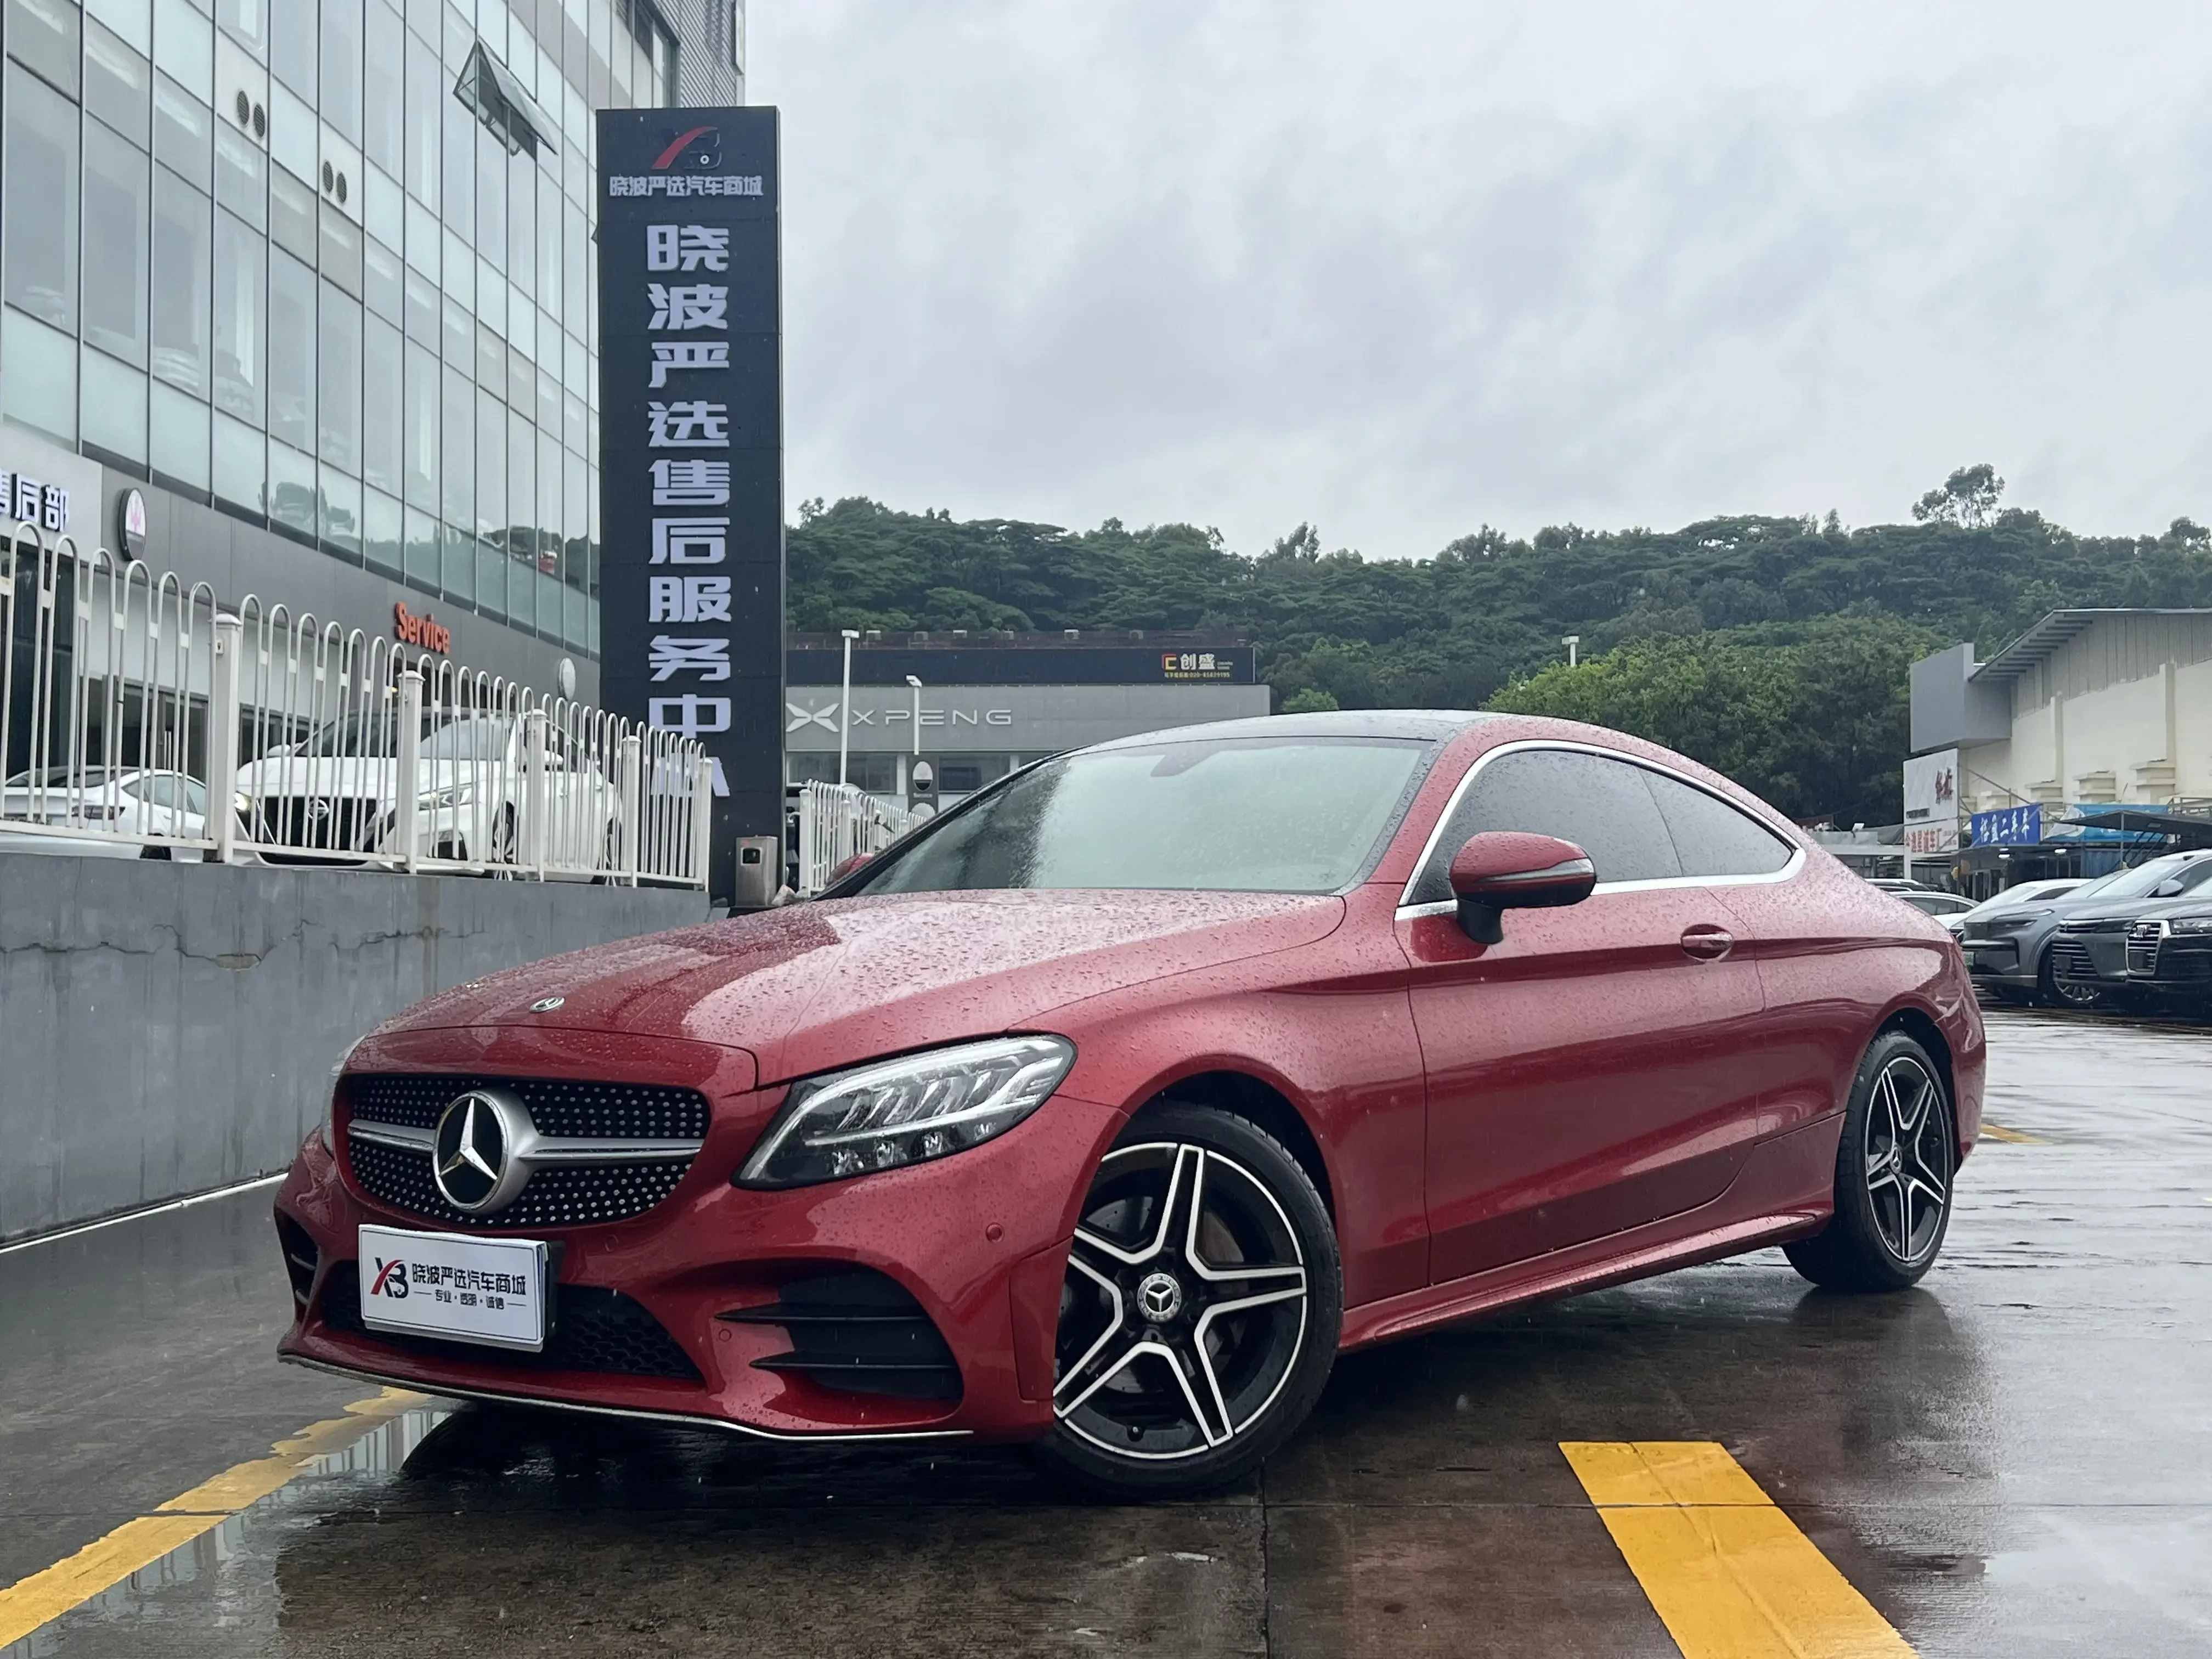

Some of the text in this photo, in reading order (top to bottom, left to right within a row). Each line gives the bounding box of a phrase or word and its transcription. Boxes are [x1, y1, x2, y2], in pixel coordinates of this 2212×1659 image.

[609, 176, 764, 196] 晓波严选汽车商城
[394, 601, 450, 654] Service
[1180, 653, 1215, 670] 创盛
[851, 709, 1012, 726] XPENG
[412, 1263, 527, 1295] 晓波严选汽车商城
